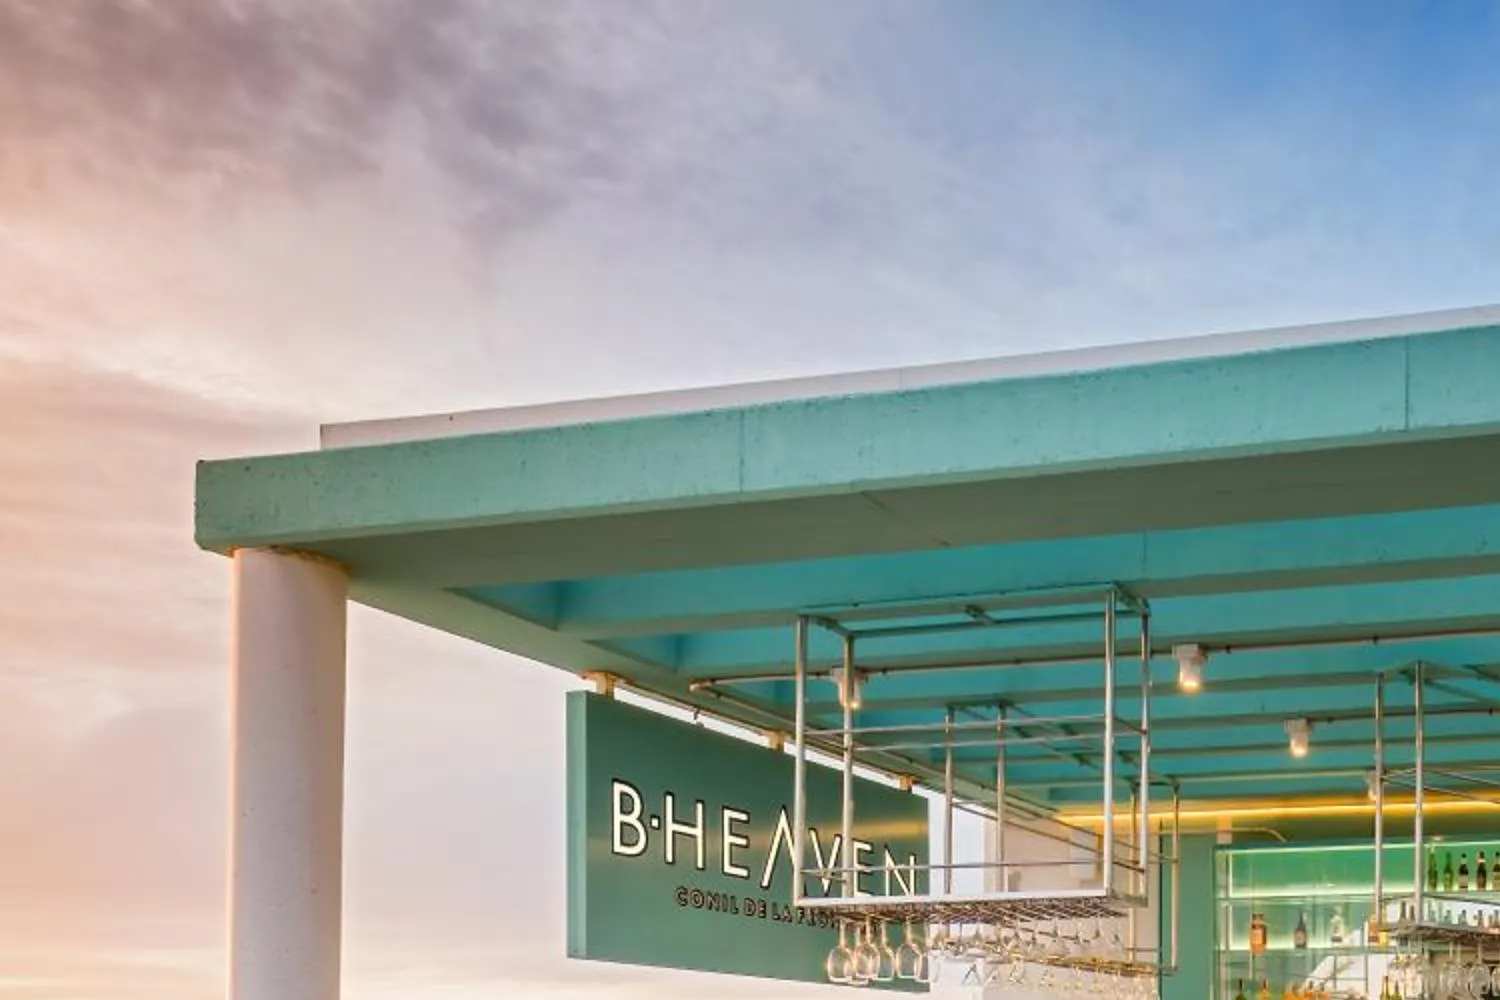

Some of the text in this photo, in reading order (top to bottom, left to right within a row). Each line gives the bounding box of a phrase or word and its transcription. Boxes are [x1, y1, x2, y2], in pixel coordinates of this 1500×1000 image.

[674, 885, 739, 915] CONIL
[743, 897, 767, 919] DE
[772, 902, 793, 923] LA
